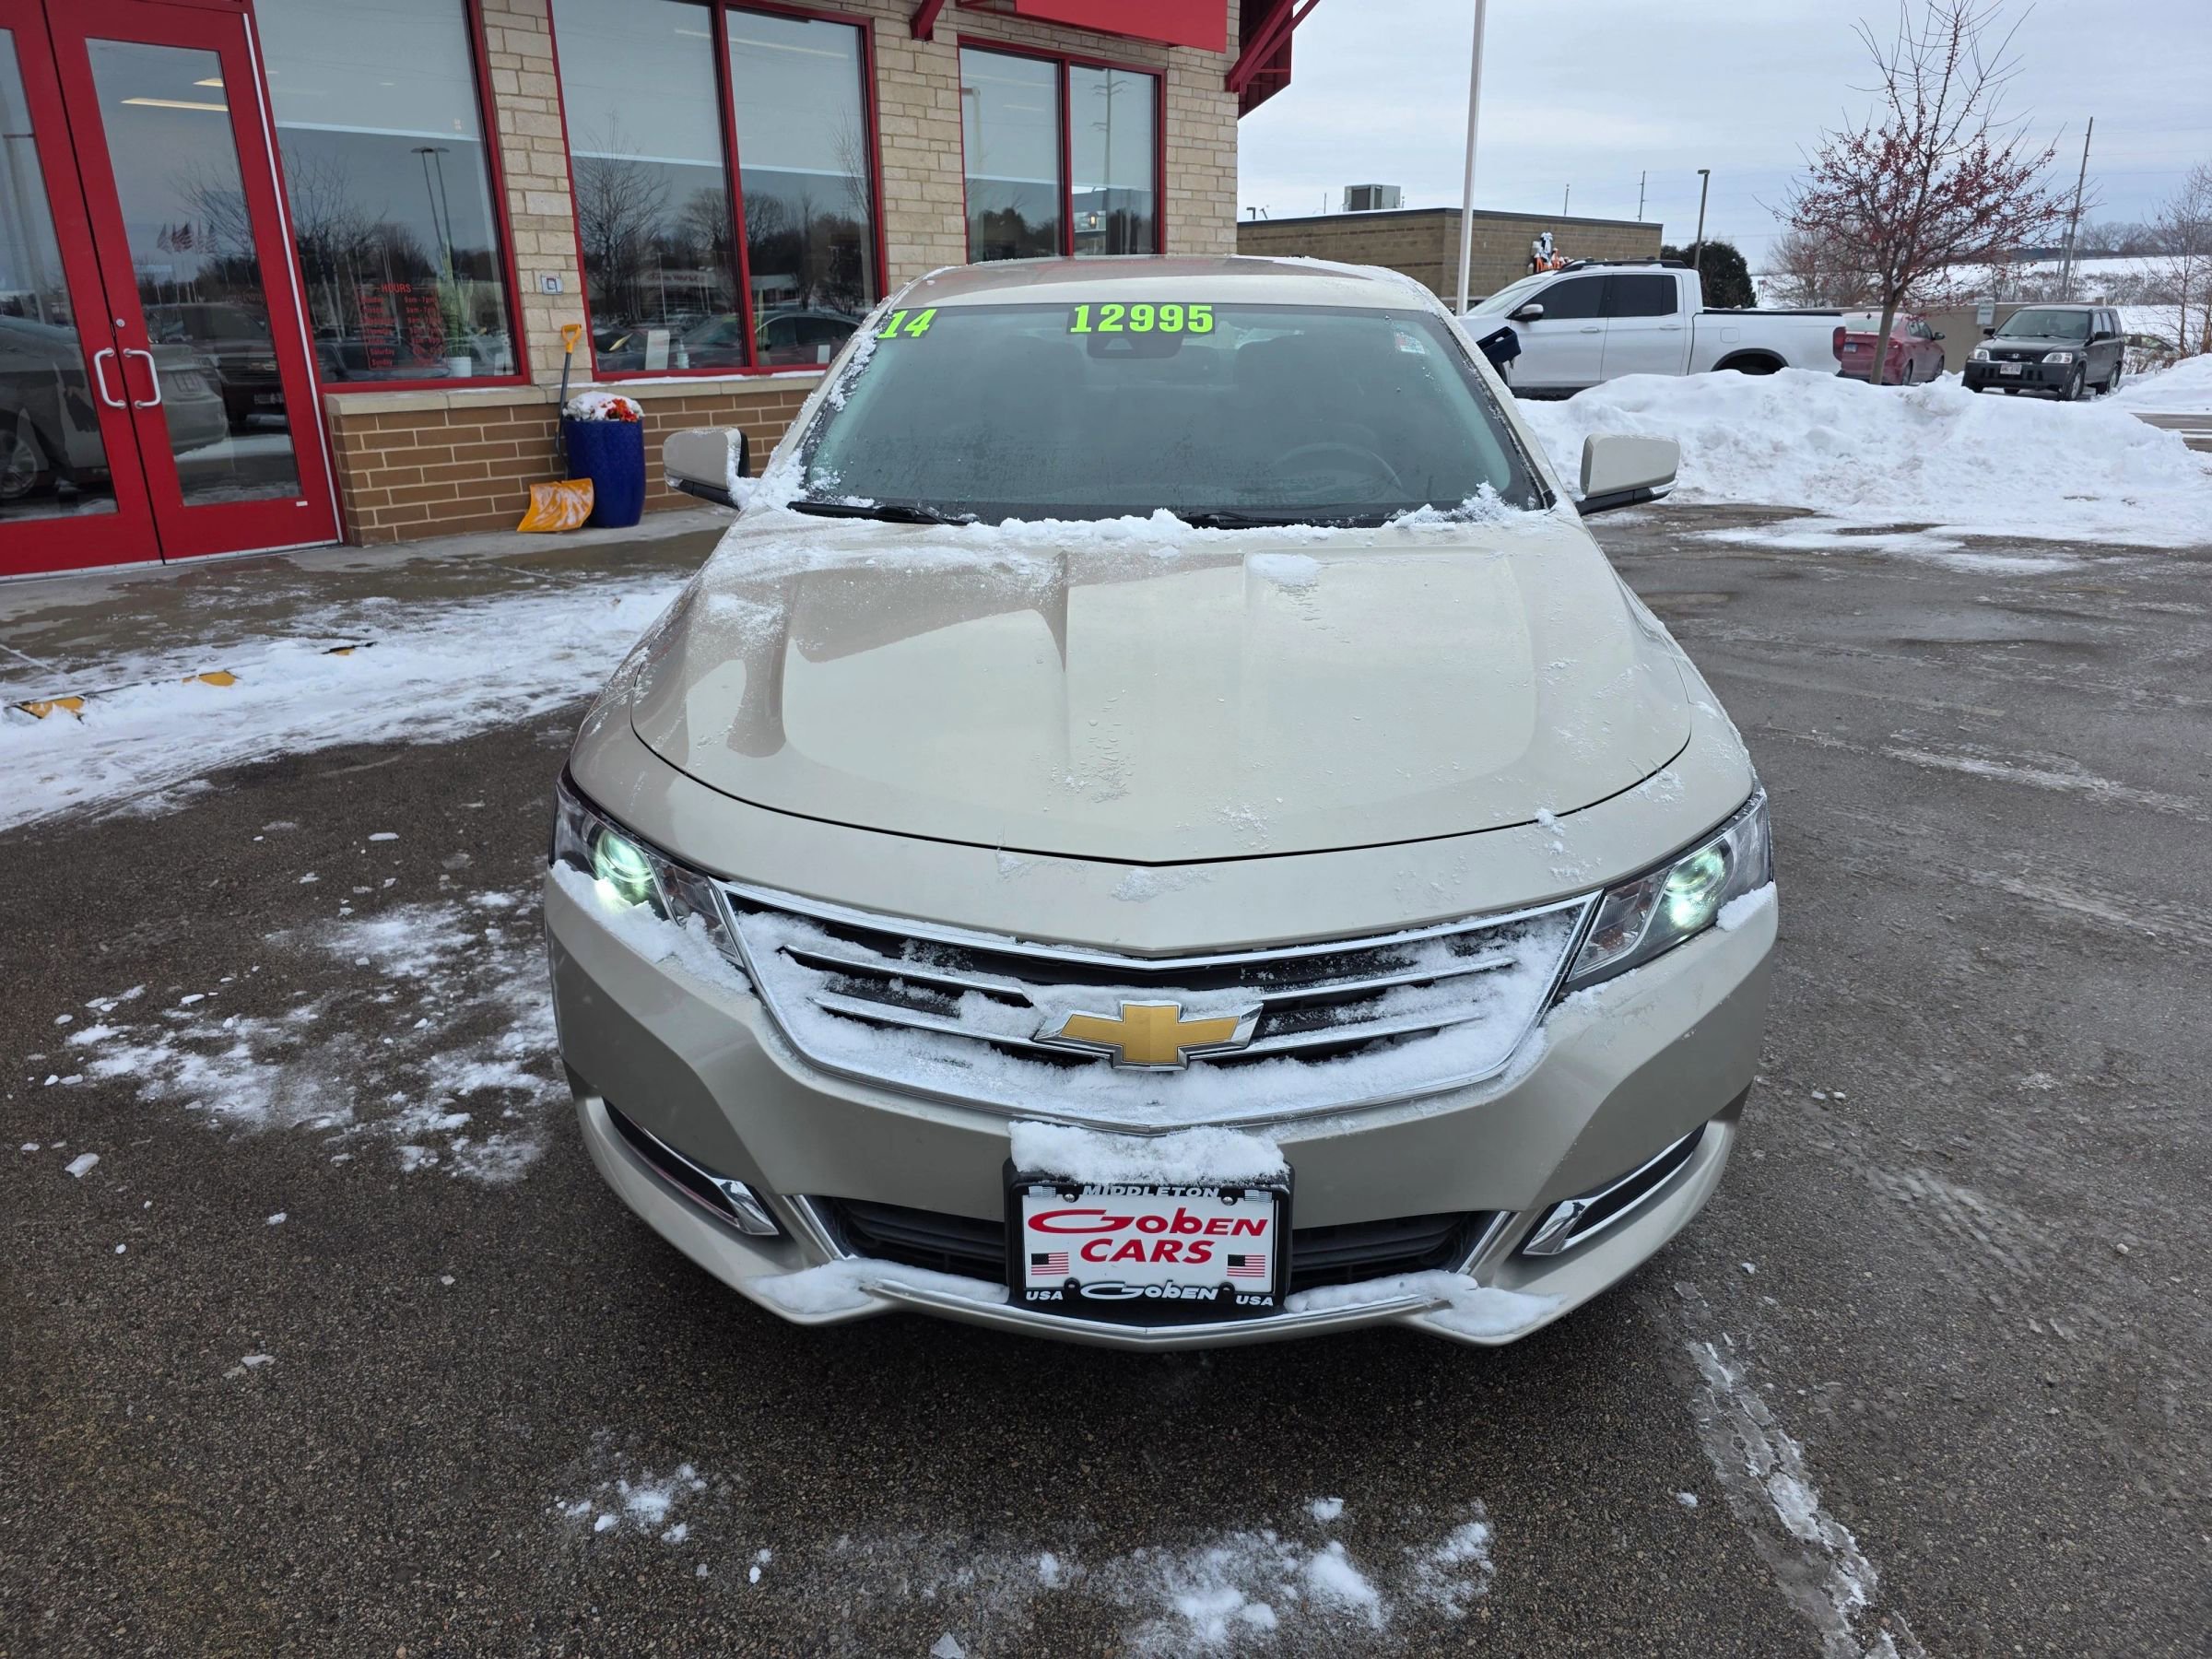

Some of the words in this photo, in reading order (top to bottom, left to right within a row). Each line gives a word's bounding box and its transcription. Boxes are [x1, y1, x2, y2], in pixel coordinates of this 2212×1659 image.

[382, 284, 411, 293] HOURS
[877, 309, 937, 339] 14
[1070, 304, 1213, 333] 12995
[1082, 1184, 1220, 1198] MIDDLETON
[1080, 1238, 1216, 1265] CARS
[1026, 1289, 1064, 1301] USA
[1235, 1295, 1274, 1307] USA
